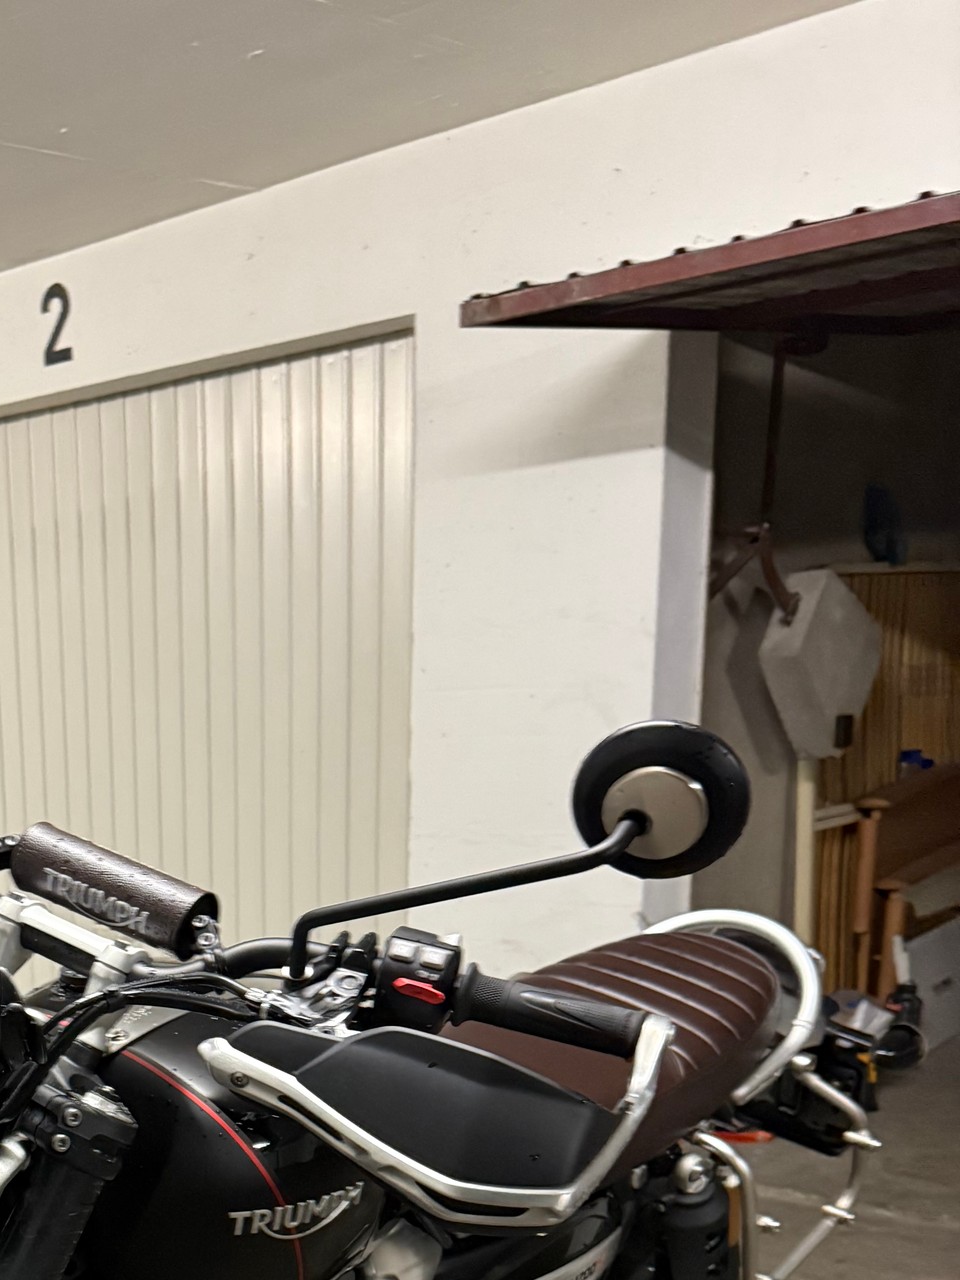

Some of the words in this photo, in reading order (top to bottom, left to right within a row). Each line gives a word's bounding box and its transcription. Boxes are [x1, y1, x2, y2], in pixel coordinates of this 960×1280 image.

[40, 282, 73, 367] 2
[42, 866, 150, 934] TRIUMPH
[227, 1180, 365, 1240] TRIUMPH
